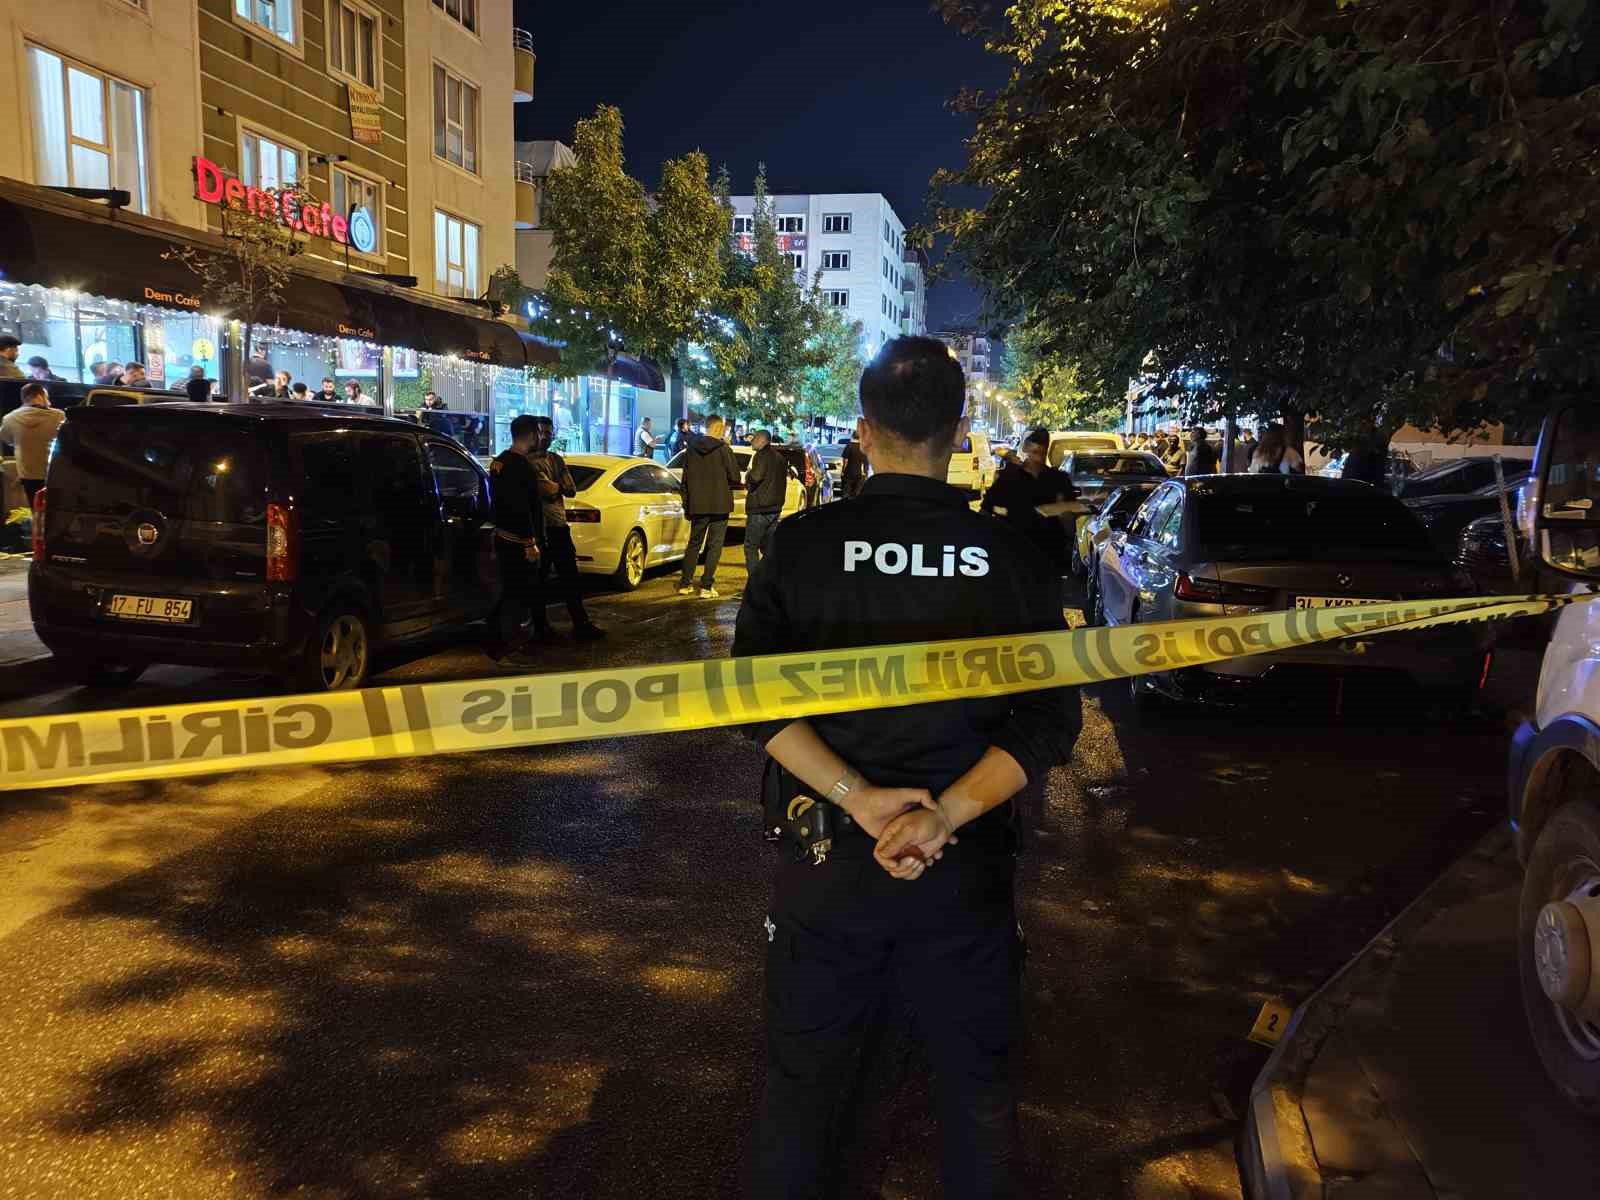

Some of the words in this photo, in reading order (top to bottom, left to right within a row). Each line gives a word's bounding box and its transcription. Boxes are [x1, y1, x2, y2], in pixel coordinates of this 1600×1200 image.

[194, 156, 277, 224] Dem
[281, 190, 349, 244] Cafe
[144, 287, 173, 302] Dem
[338, 324, 356, 335] Dem
[113, 598, 127, 612] 17
[136, 599, 153, 615] FU
[164, 601, 190, 618] 854
[1267, 1013, 1279, 1032] 2
